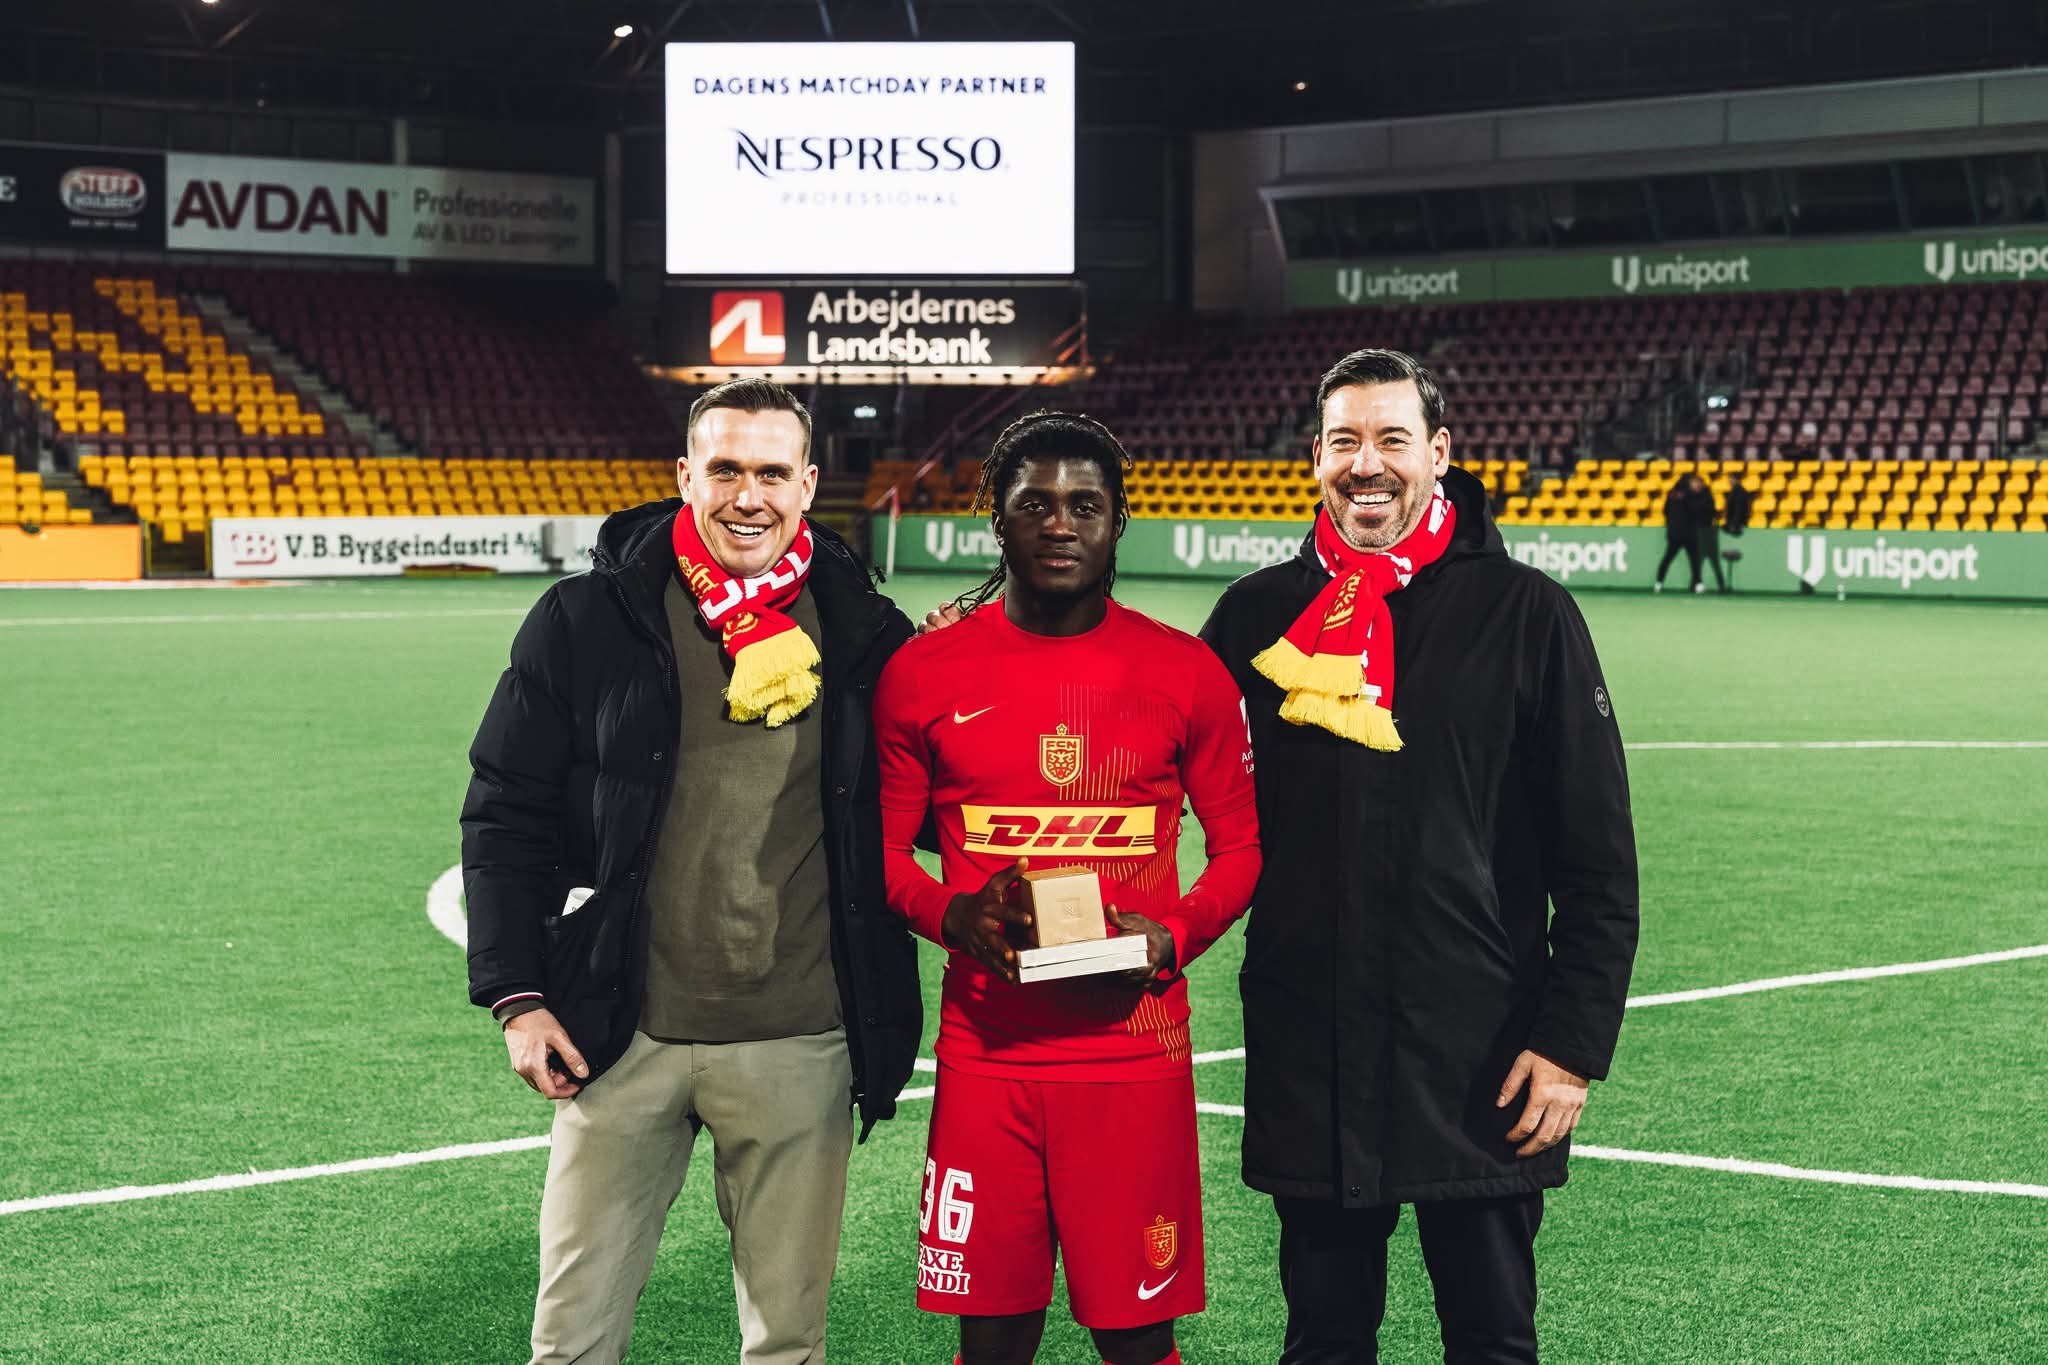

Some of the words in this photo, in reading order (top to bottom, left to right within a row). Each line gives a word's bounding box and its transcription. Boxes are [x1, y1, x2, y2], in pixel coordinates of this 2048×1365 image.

[694, 77, 790, 95] DAGENS
[800, 77, 930, 95] MATCHDAY
[941, 77, 1048, 95] PARTNER
[735, 128, 1002, 178] NESPRESSO
[172, 179, 389, 236] AVDAN
[781, 191, 959, 205] PROFESSIONAL
[1366, 268, 1459, 300] unisport
[1644, 254, 1750, 291] unisport
[807, 289, 1016, 331] Arbejdernes
[807, 328, 993, 364] Landsbank
[1208, 526, 1303, 568] unispo
[1833, 537, 1979, 588] unisport
[986, 814, 1135, 848] DHL
[920, 1157, 975, 1244] 36
[918, 1267, 971, 1295] ONDI
